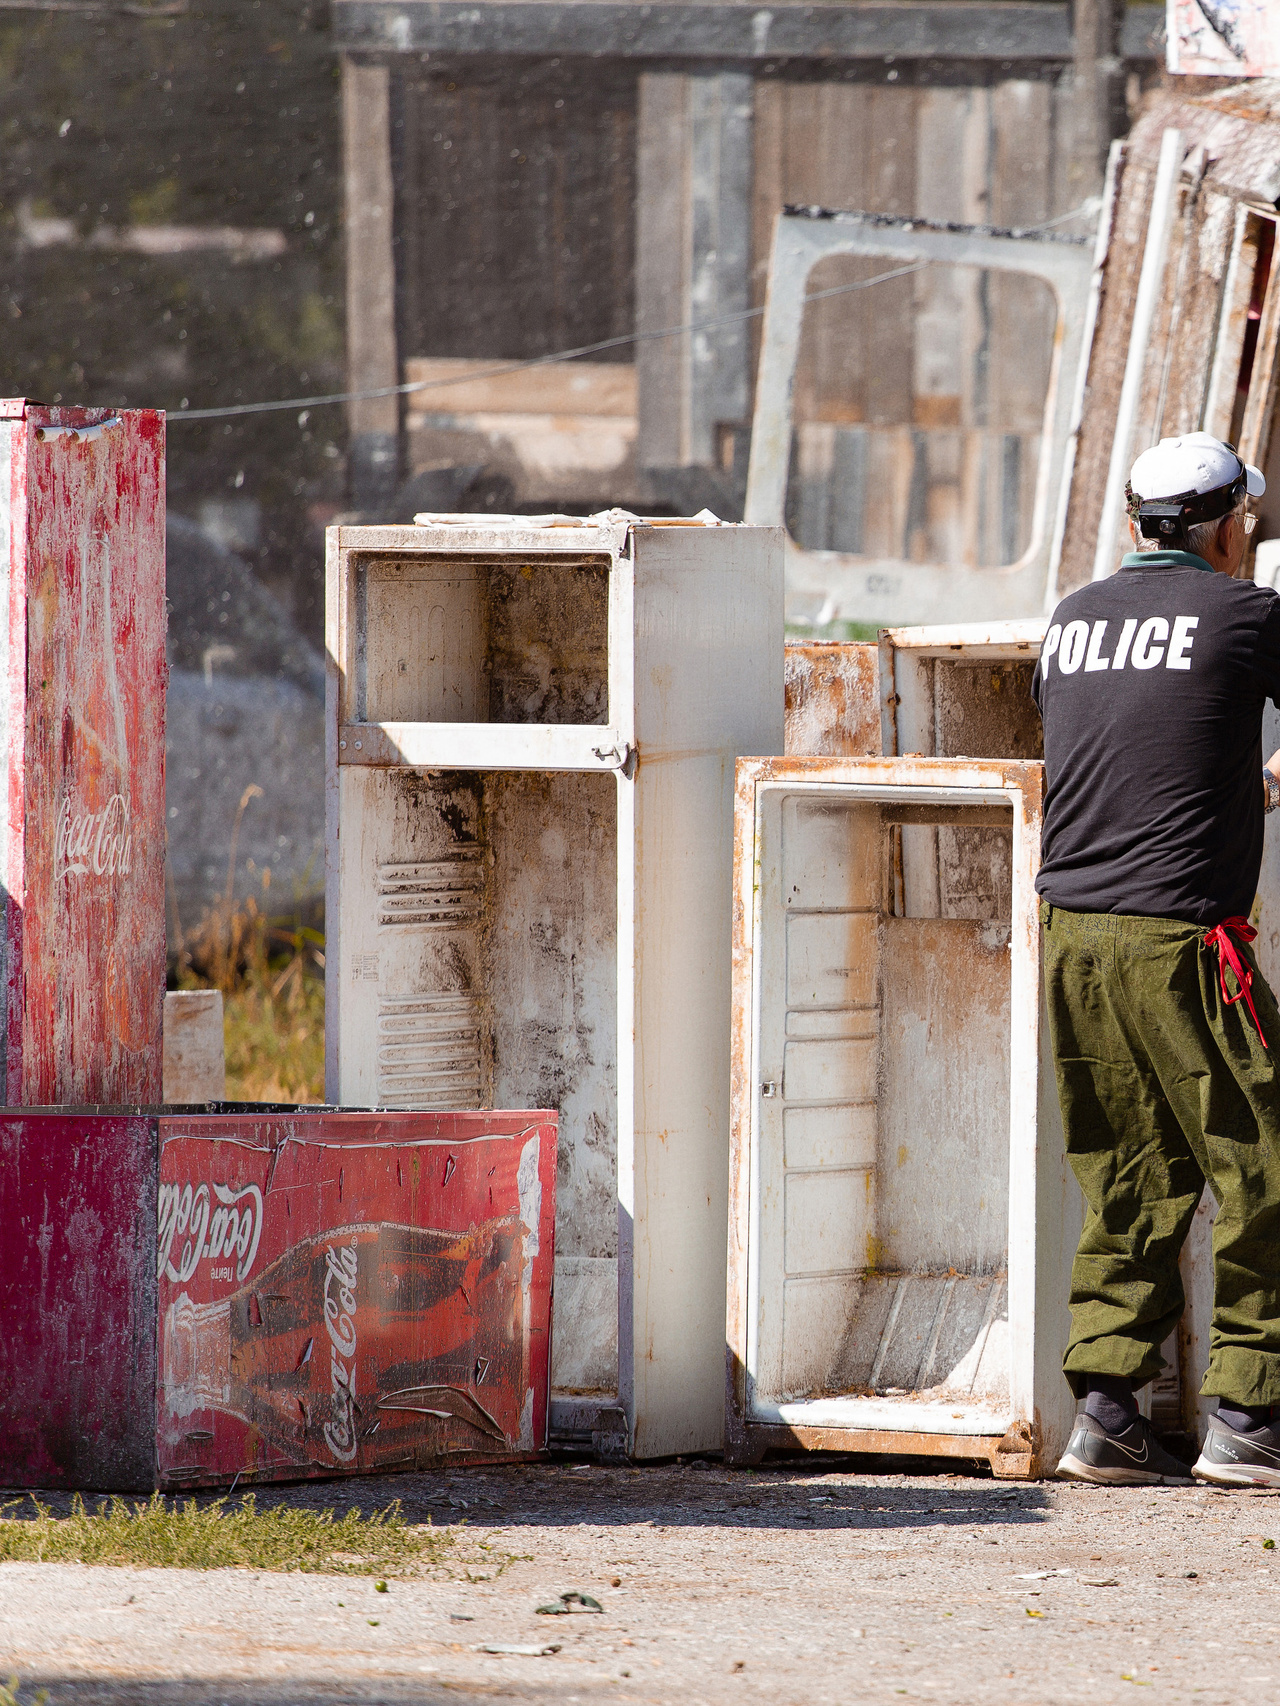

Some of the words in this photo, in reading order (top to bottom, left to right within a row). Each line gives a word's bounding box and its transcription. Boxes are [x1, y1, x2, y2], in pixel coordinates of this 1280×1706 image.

[1040, 615, 1200, 681] POLICE
[53, 794, 132, 881] Coca-Cola
[157, 1181, 263, 1283] Coca-Cola
[210, 1266, 234, 1282] Пейте
